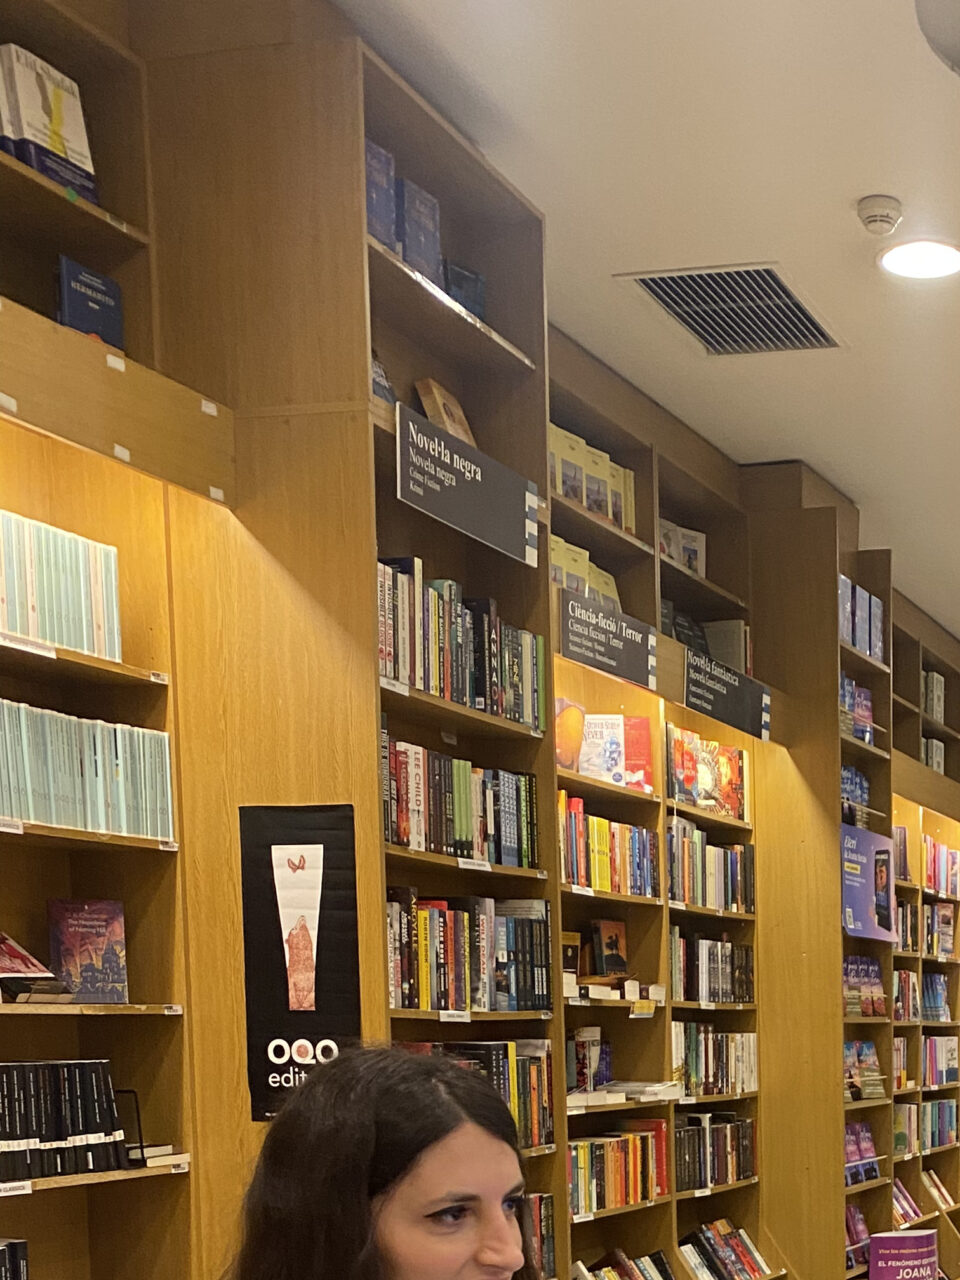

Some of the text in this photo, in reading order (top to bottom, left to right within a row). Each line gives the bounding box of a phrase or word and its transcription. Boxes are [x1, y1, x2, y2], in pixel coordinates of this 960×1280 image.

[409, 446, 457, 486] Novela negra
[453, 454, 482, 482] negra
[609, 633, 624, 649] Terror
[621, 622, 643, 643] Terror
[267, 1038, 339, 1065] OQO
[888, 1258, 921, 1267] FENÓMENO
[896, 1266, 932, 1280] JOANA
